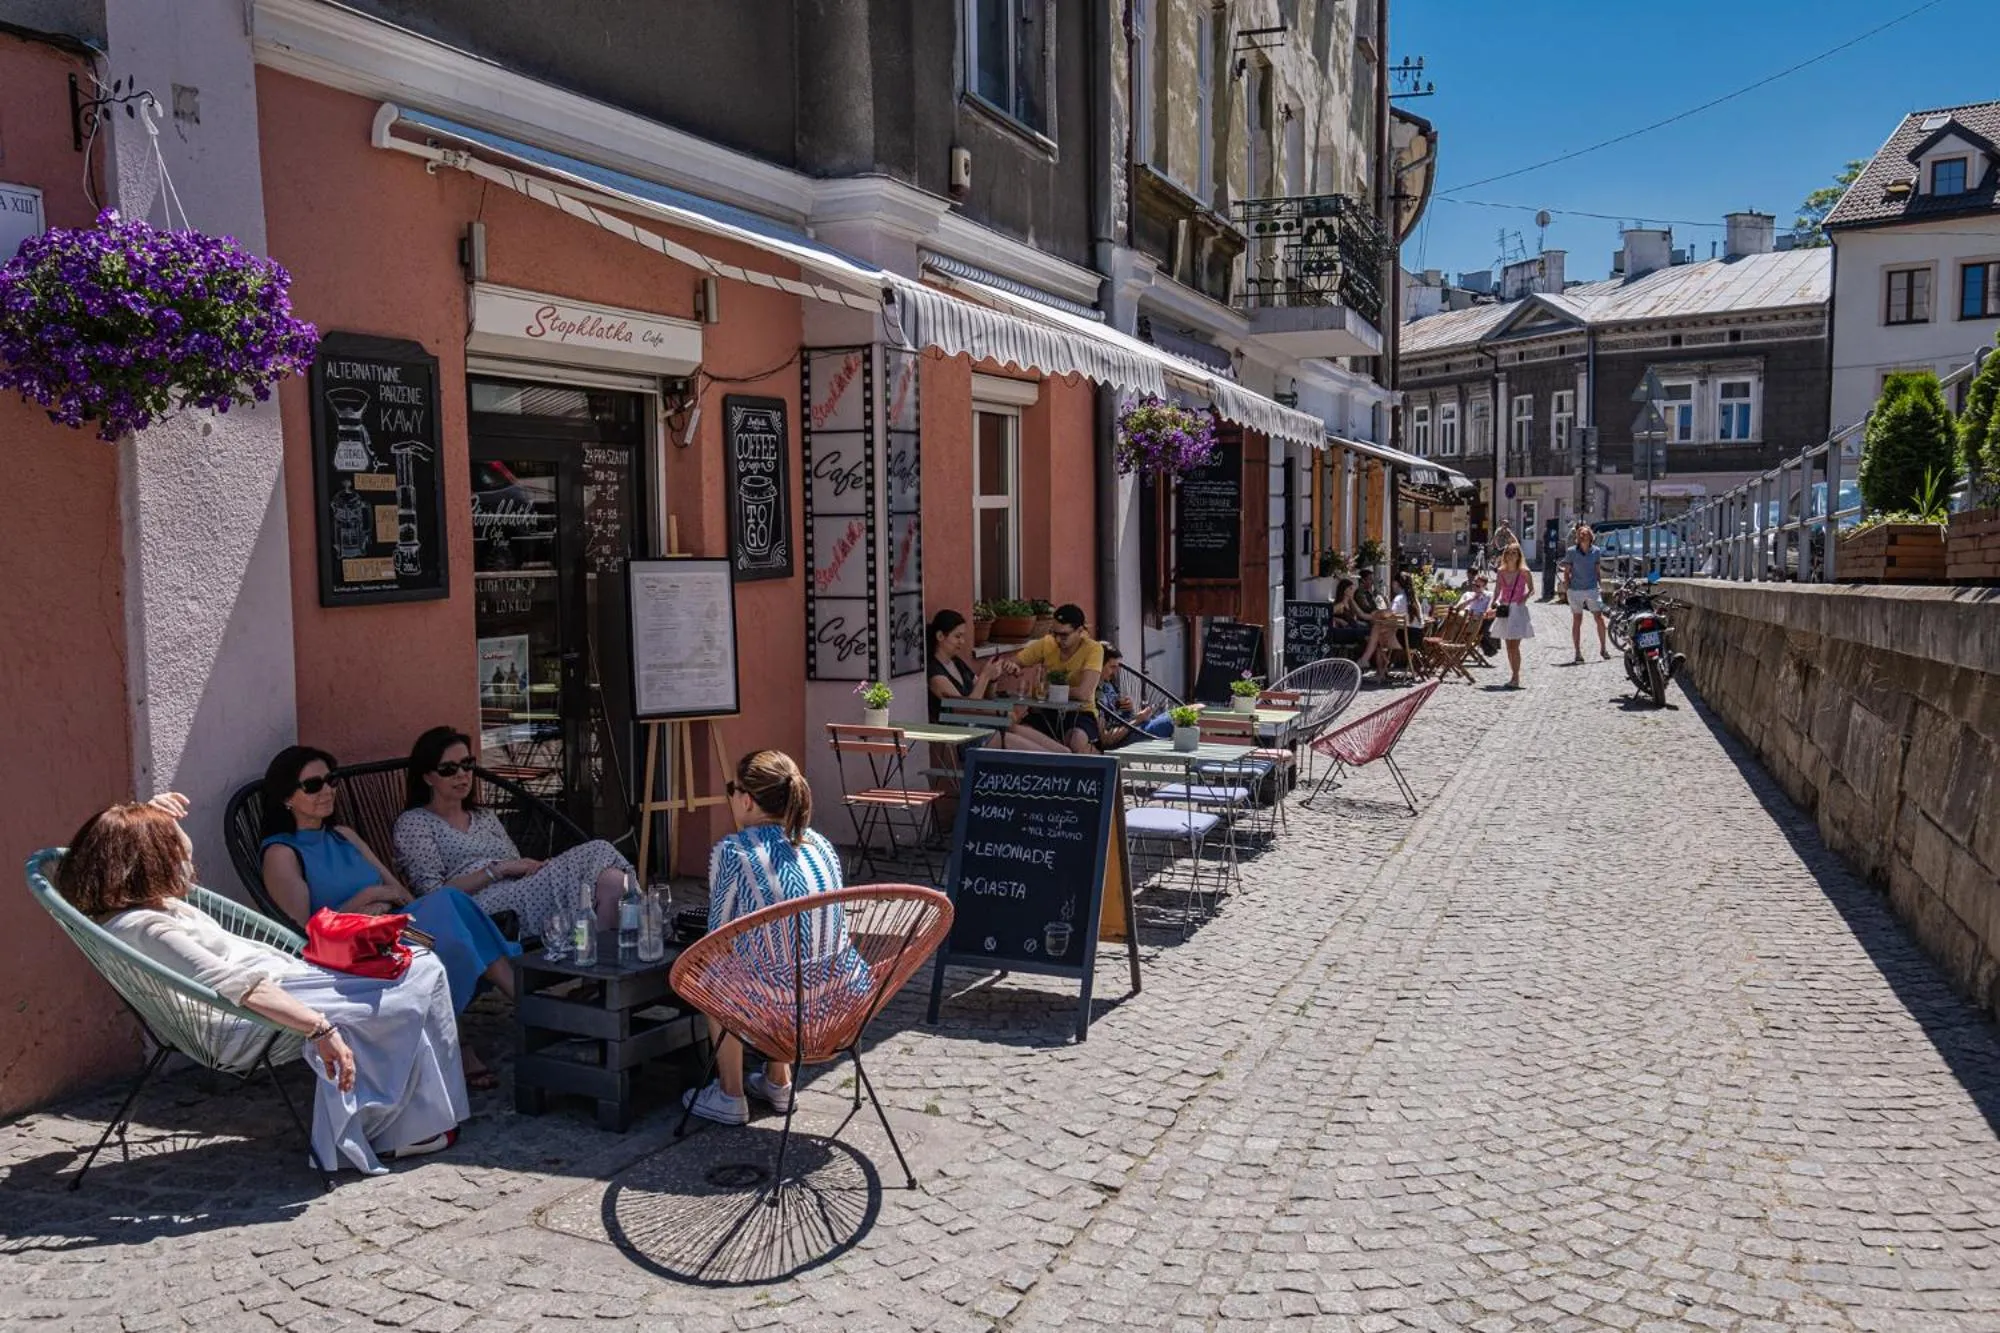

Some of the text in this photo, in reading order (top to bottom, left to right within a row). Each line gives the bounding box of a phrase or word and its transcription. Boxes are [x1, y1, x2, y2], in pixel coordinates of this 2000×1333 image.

[11, 197, 33, 214] XIII
[526, 305, 634, 344] Stopklatka
[326, 360, 402, 384] ALTERNATYWNE
[379, 384, 424, 406] PARZENIE
[380, 407, 424, 434] KAWY
[735, 432, 778, 461] COFFEE
[813, 451, 864, 497] Cafe
[746, 504, 768, 524] TO
[746, 524, 768, 548] GO
[817, 616, 867, 662] Cafe
[975, 771, 1071, 791] ZAPRASZAMY
[980, 804, 1015, 821] KAWY
[1029, 812, 1045, 824] na
[1028, 826, 1083, 840] na zimno
[975, 842, 1056, 870] LEMONIADĘ
[974, 877, 1027, 899] CIASTA
